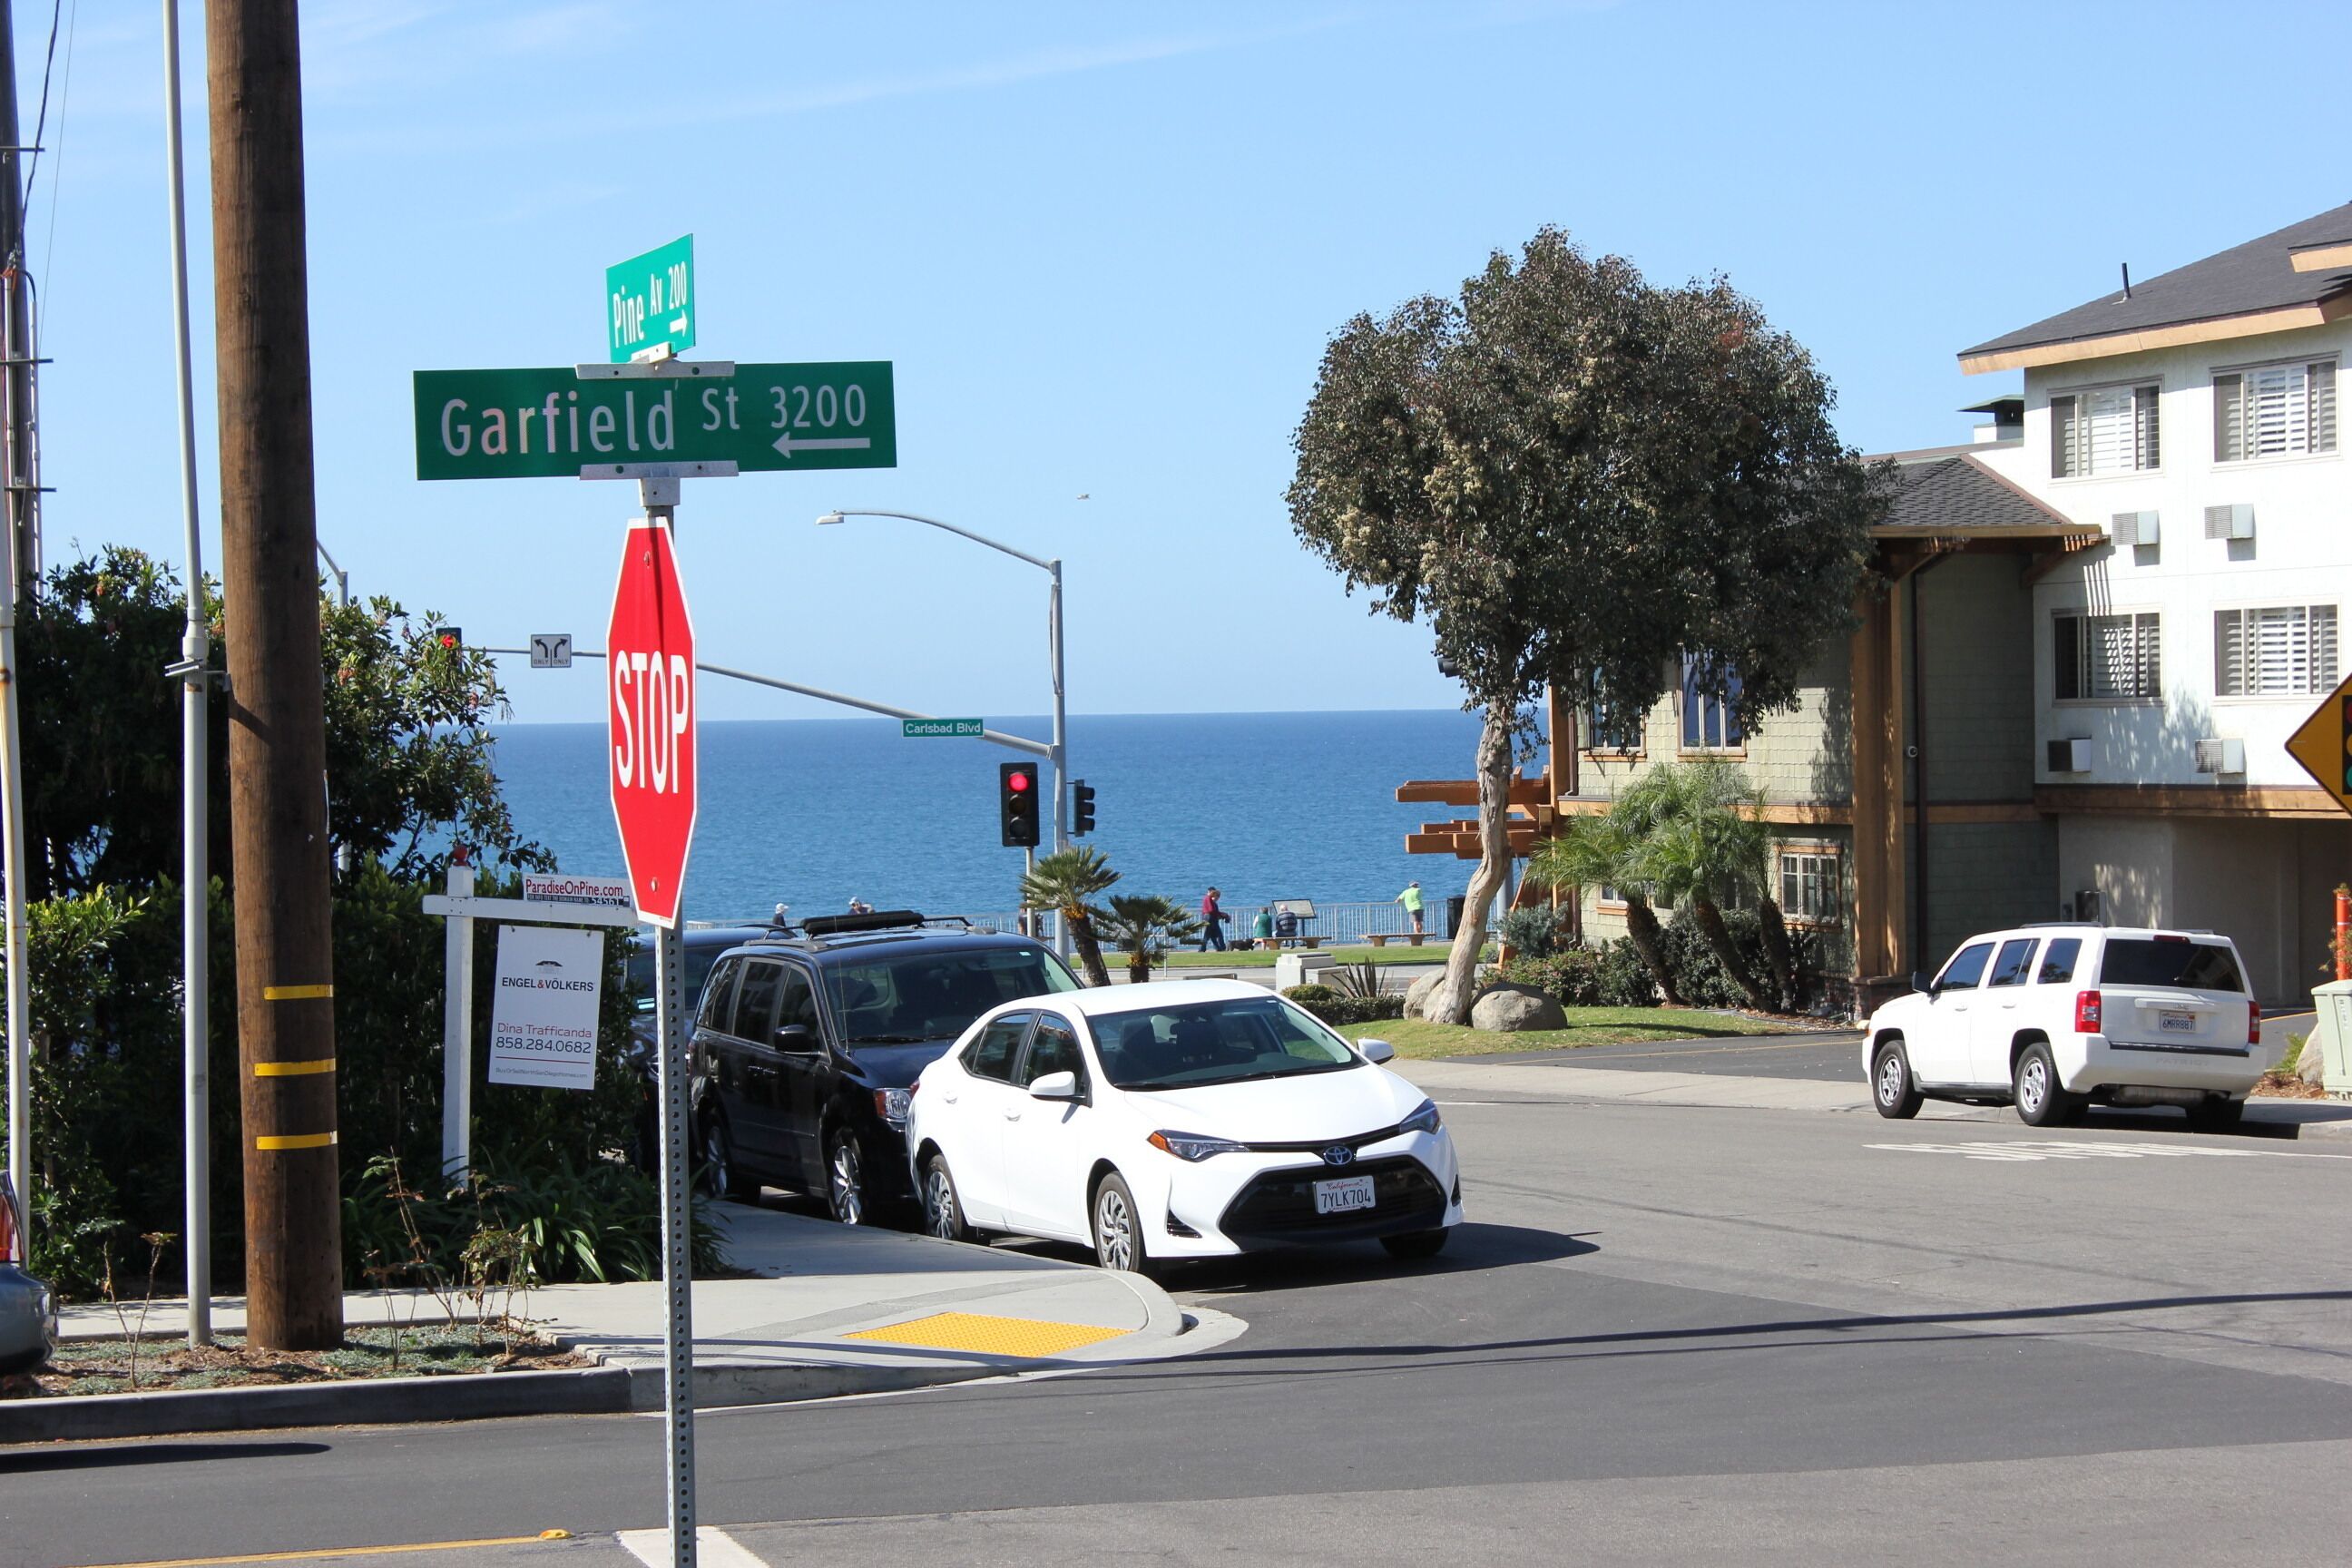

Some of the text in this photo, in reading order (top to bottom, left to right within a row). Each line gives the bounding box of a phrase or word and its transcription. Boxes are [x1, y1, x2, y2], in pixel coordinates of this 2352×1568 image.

[612, 260, 687, 348] Pine Av 200
[441, 383, 867, 456] Garfield St 3200
[614, 650, 689, 794] STOP
[906, 722, 981, 733] Carlsbad Blvd
[525, 878, 623, 897] ParadiseOnPine.com
[592, 897, 619, 906] 54561
[497, 1023, 592, 1038] Dina Trafficanda
[495, 1036, 592, 1054] 858.284.0682
[1321, 1188, 1371, 1209] 7YLK704
